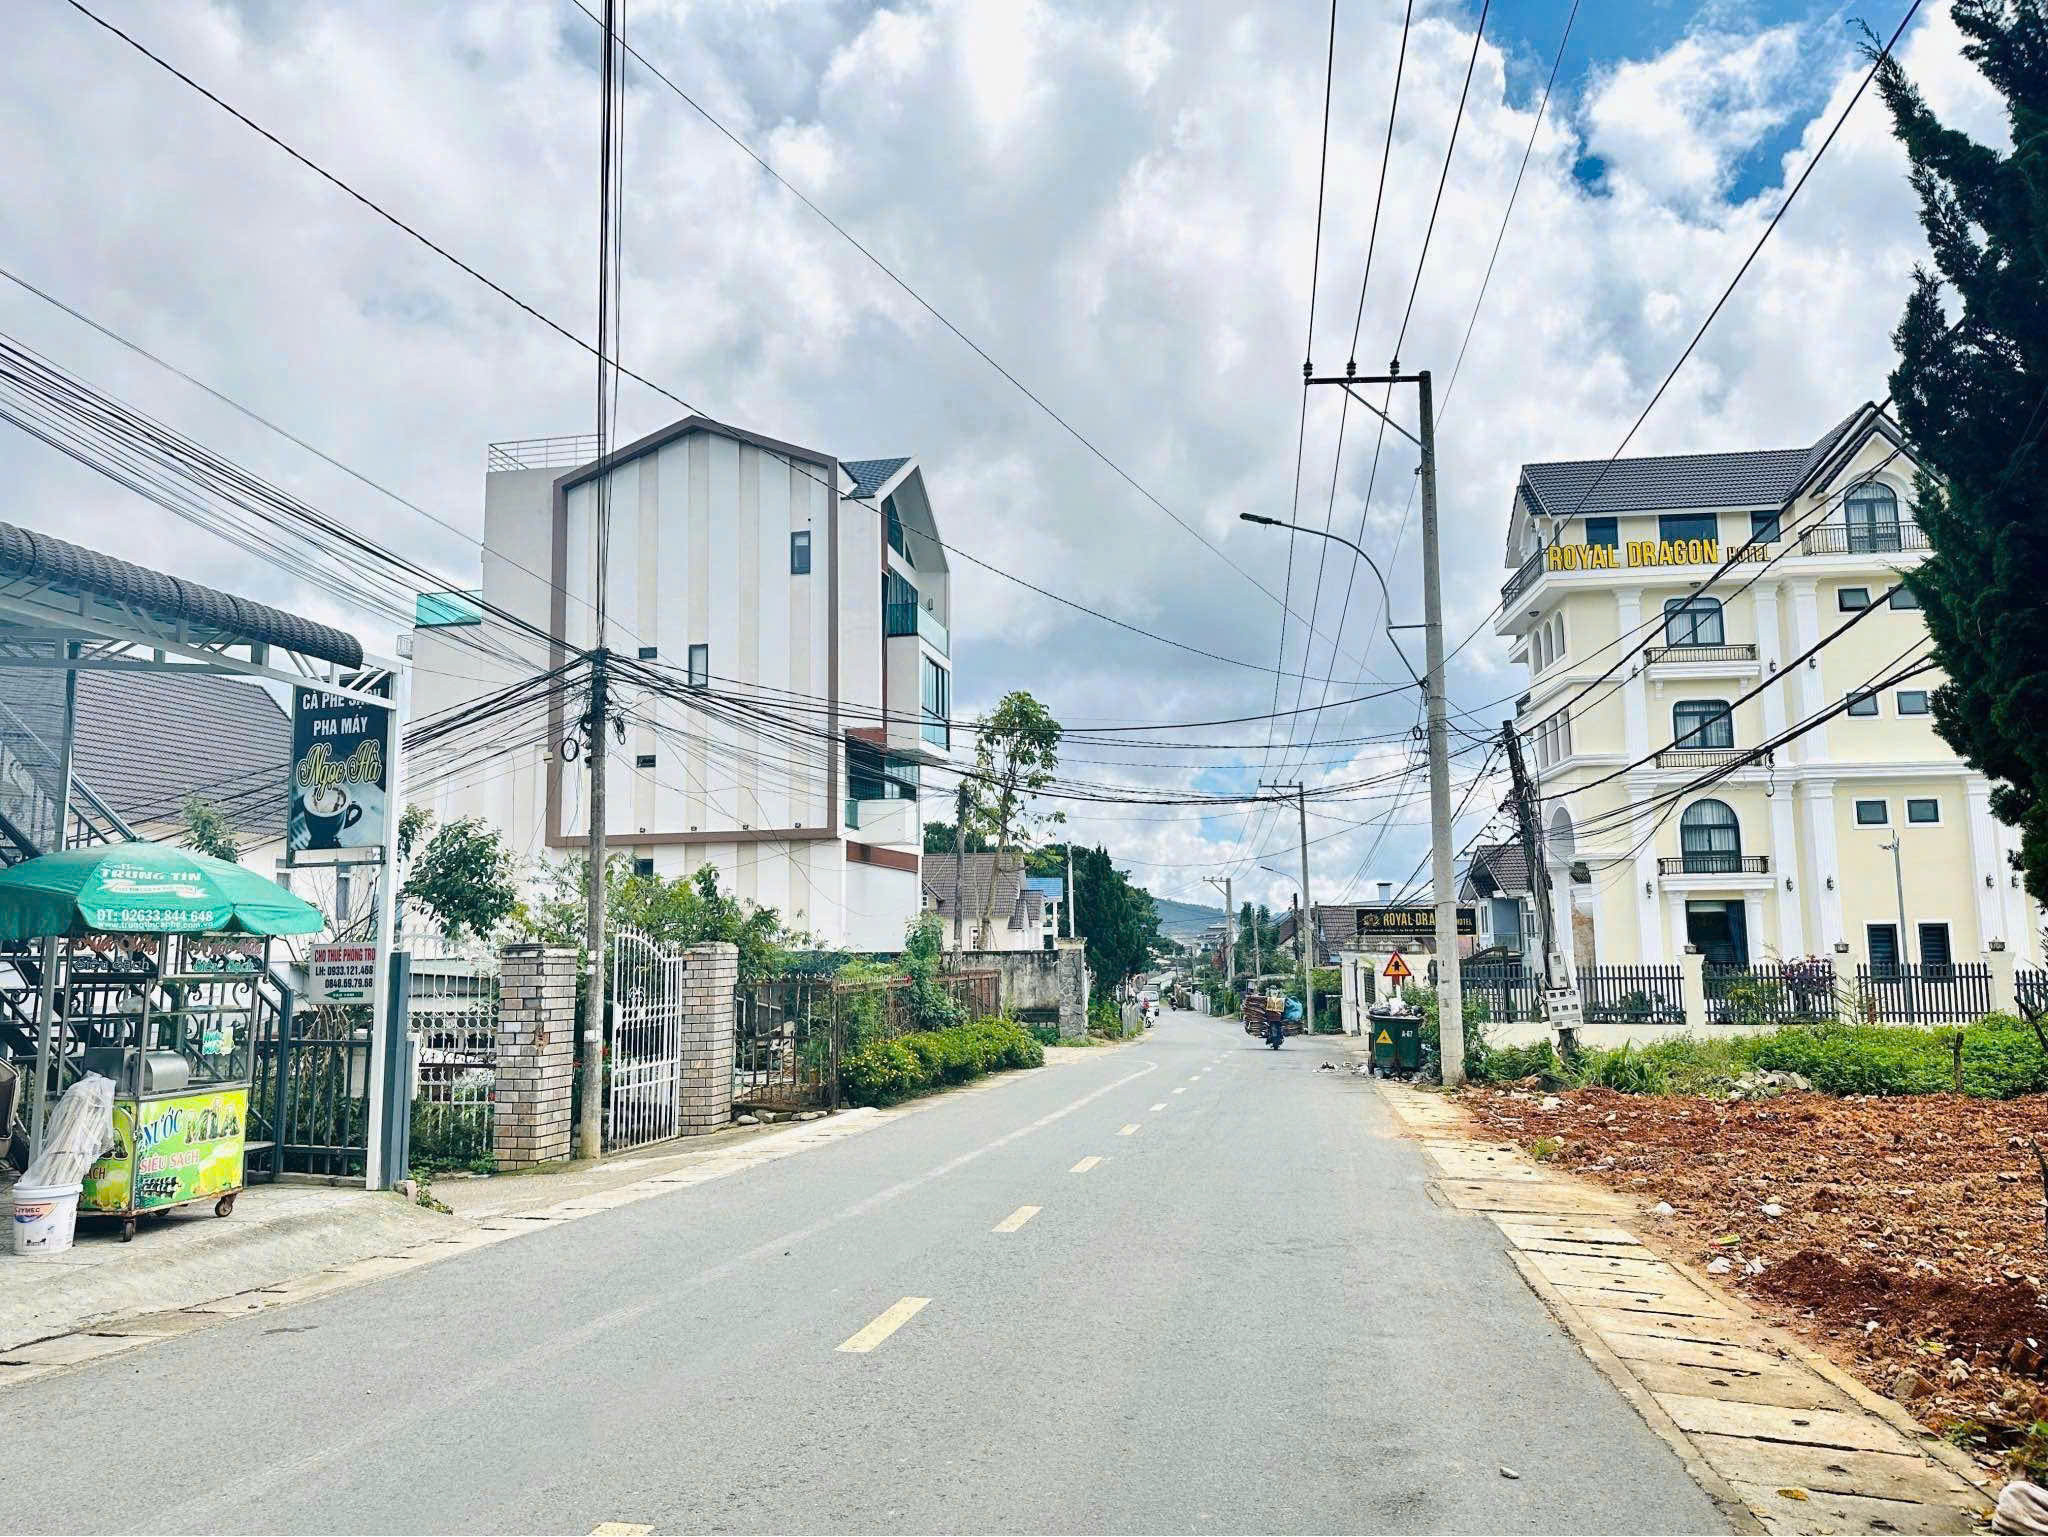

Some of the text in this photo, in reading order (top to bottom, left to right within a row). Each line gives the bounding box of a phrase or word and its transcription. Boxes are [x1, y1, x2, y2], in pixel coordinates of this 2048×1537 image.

[1548, 538, 1771, 571] ROYAL DRAGON HOTEL
[302, 690, 319, 710] CÀ
[313, 713, 368, 736] PHA MÁY
[297, 738, 383, 801] Ngọc Hà
[100, 868, 164, 881] TRUNG
[1383, 912, 1413, 926] ROYAL
[1415, 912, 1436, 926] DRA
[314, 949, 326, 963] CHO
[315, 966, 326, 976] LH:
